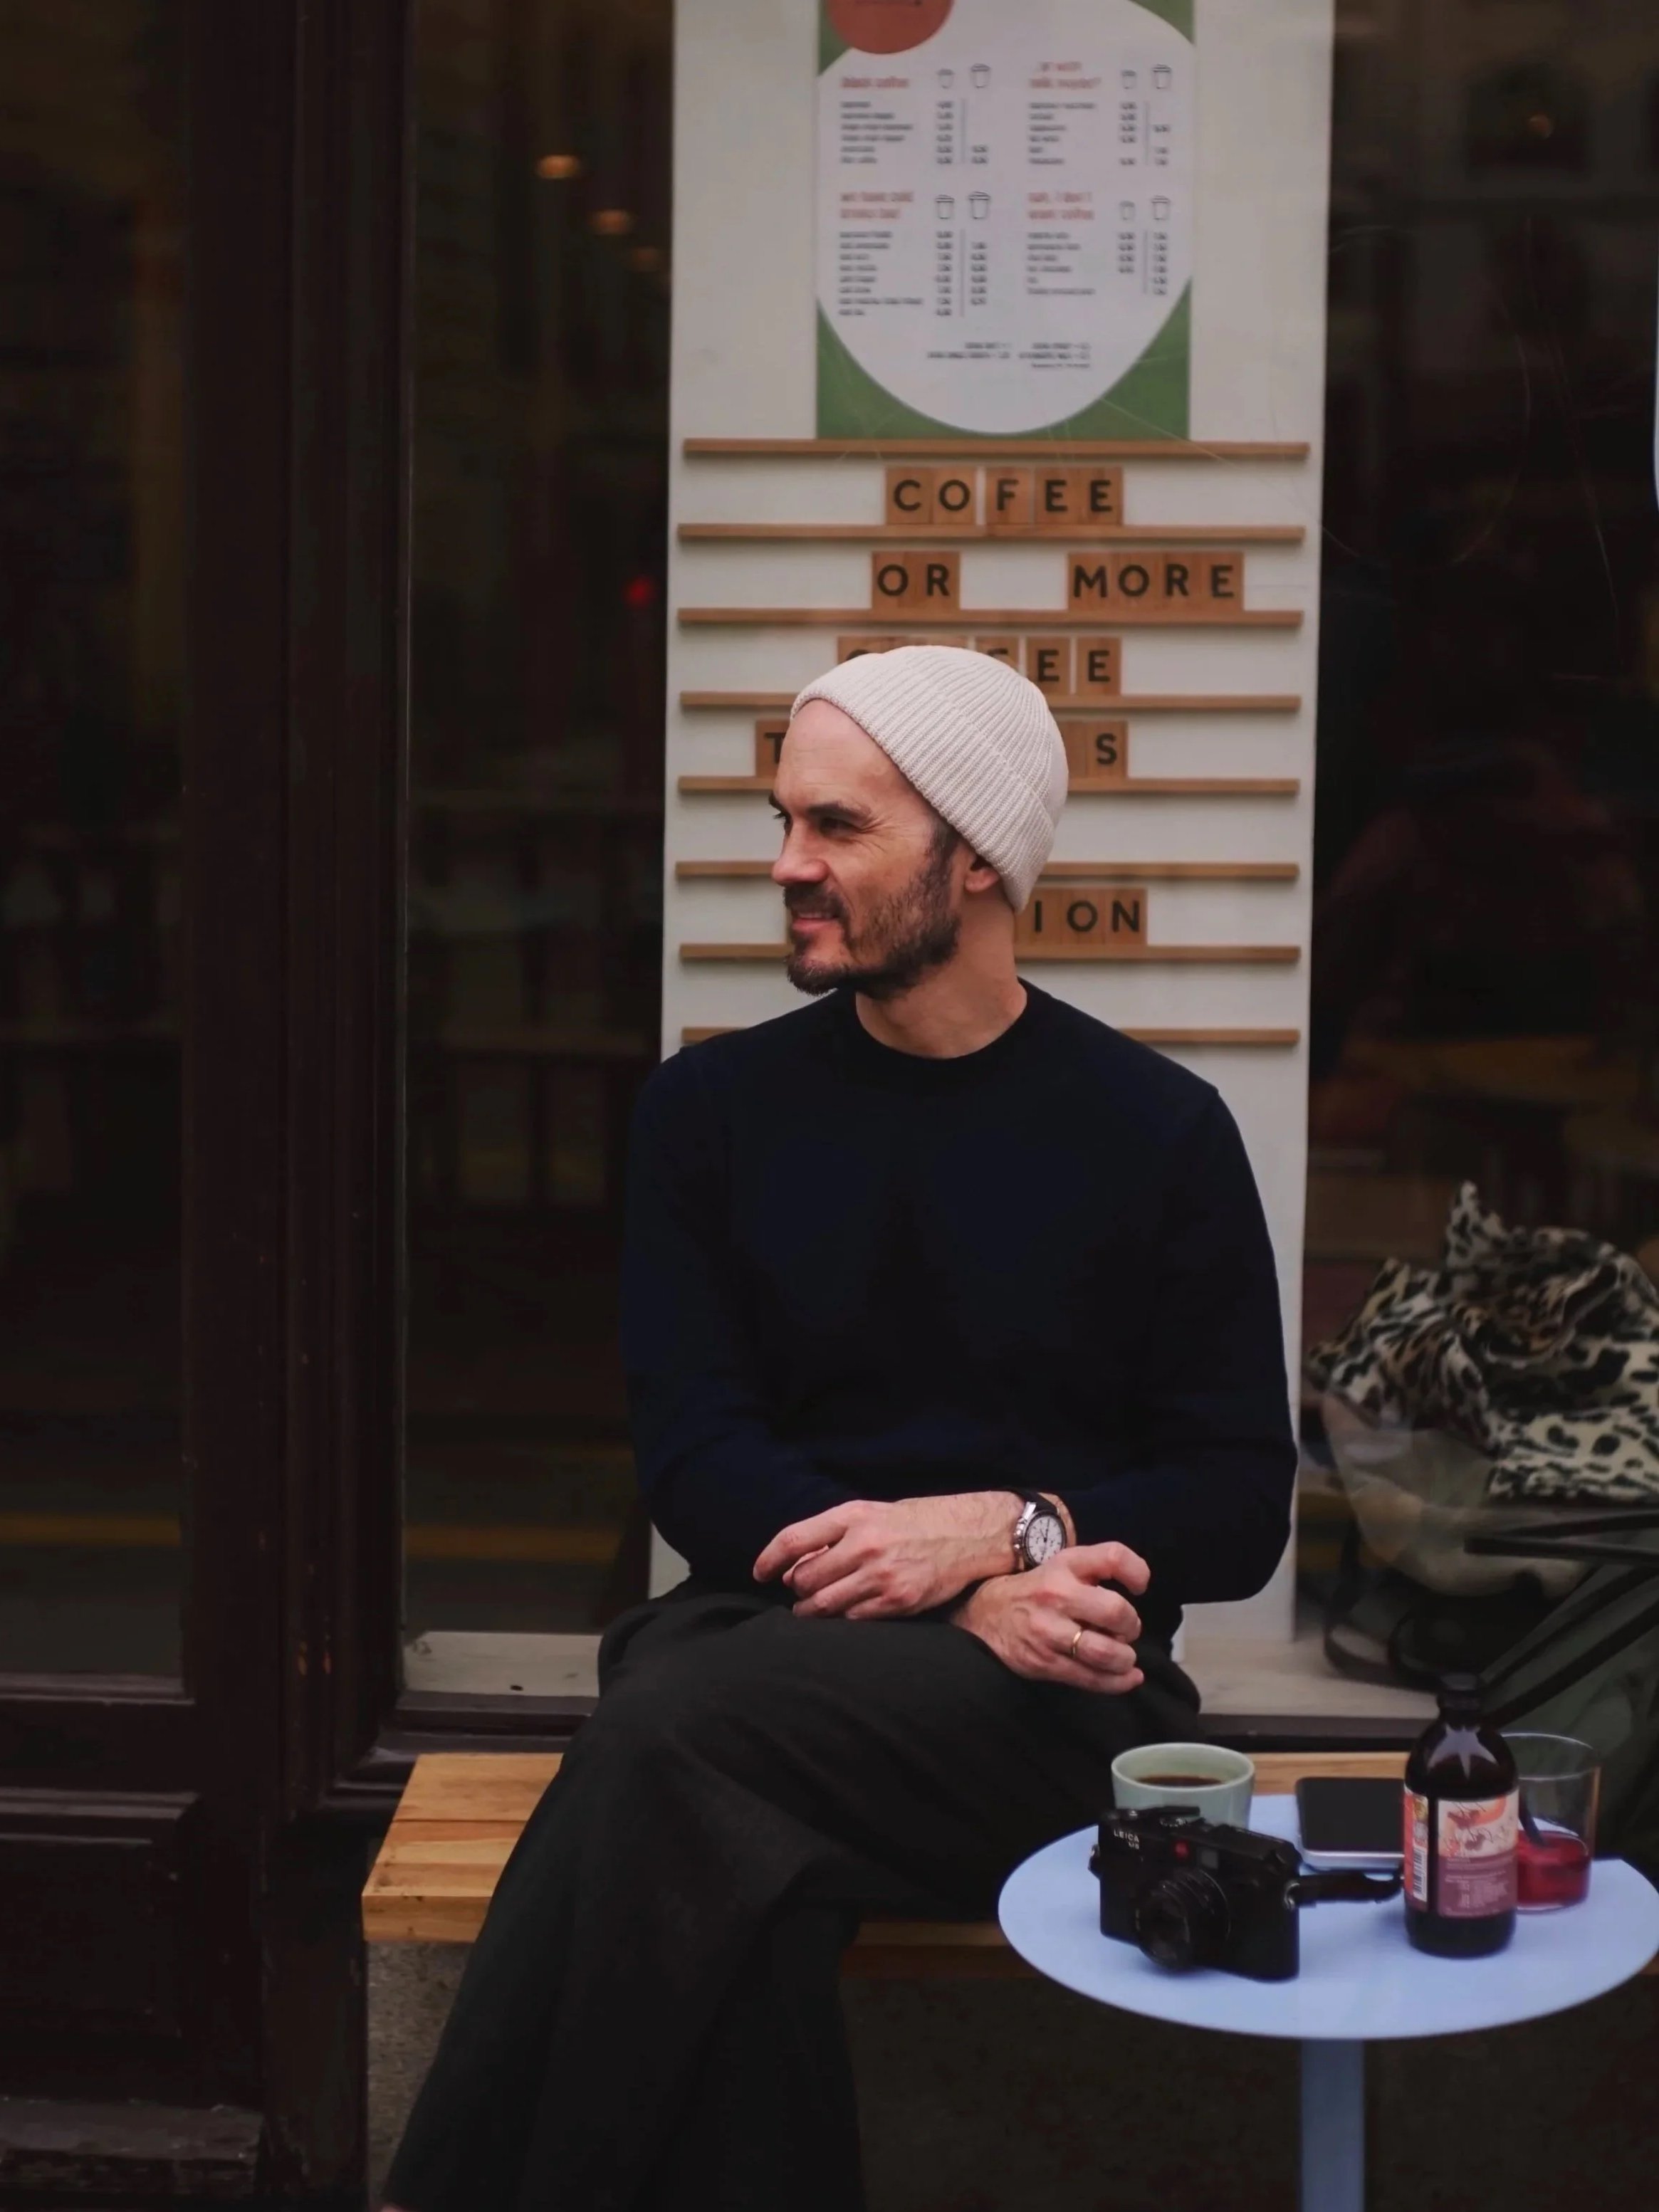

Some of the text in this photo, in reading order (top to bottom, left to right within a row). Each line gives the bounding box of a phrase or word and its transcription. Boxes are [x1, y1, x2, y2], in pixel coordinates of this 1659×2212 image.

[892, 478, 1113, 513] COFEE
[876, 563, 1235, 598] OR MORE
[1114, 1828, 1139, 1843] LEICA
